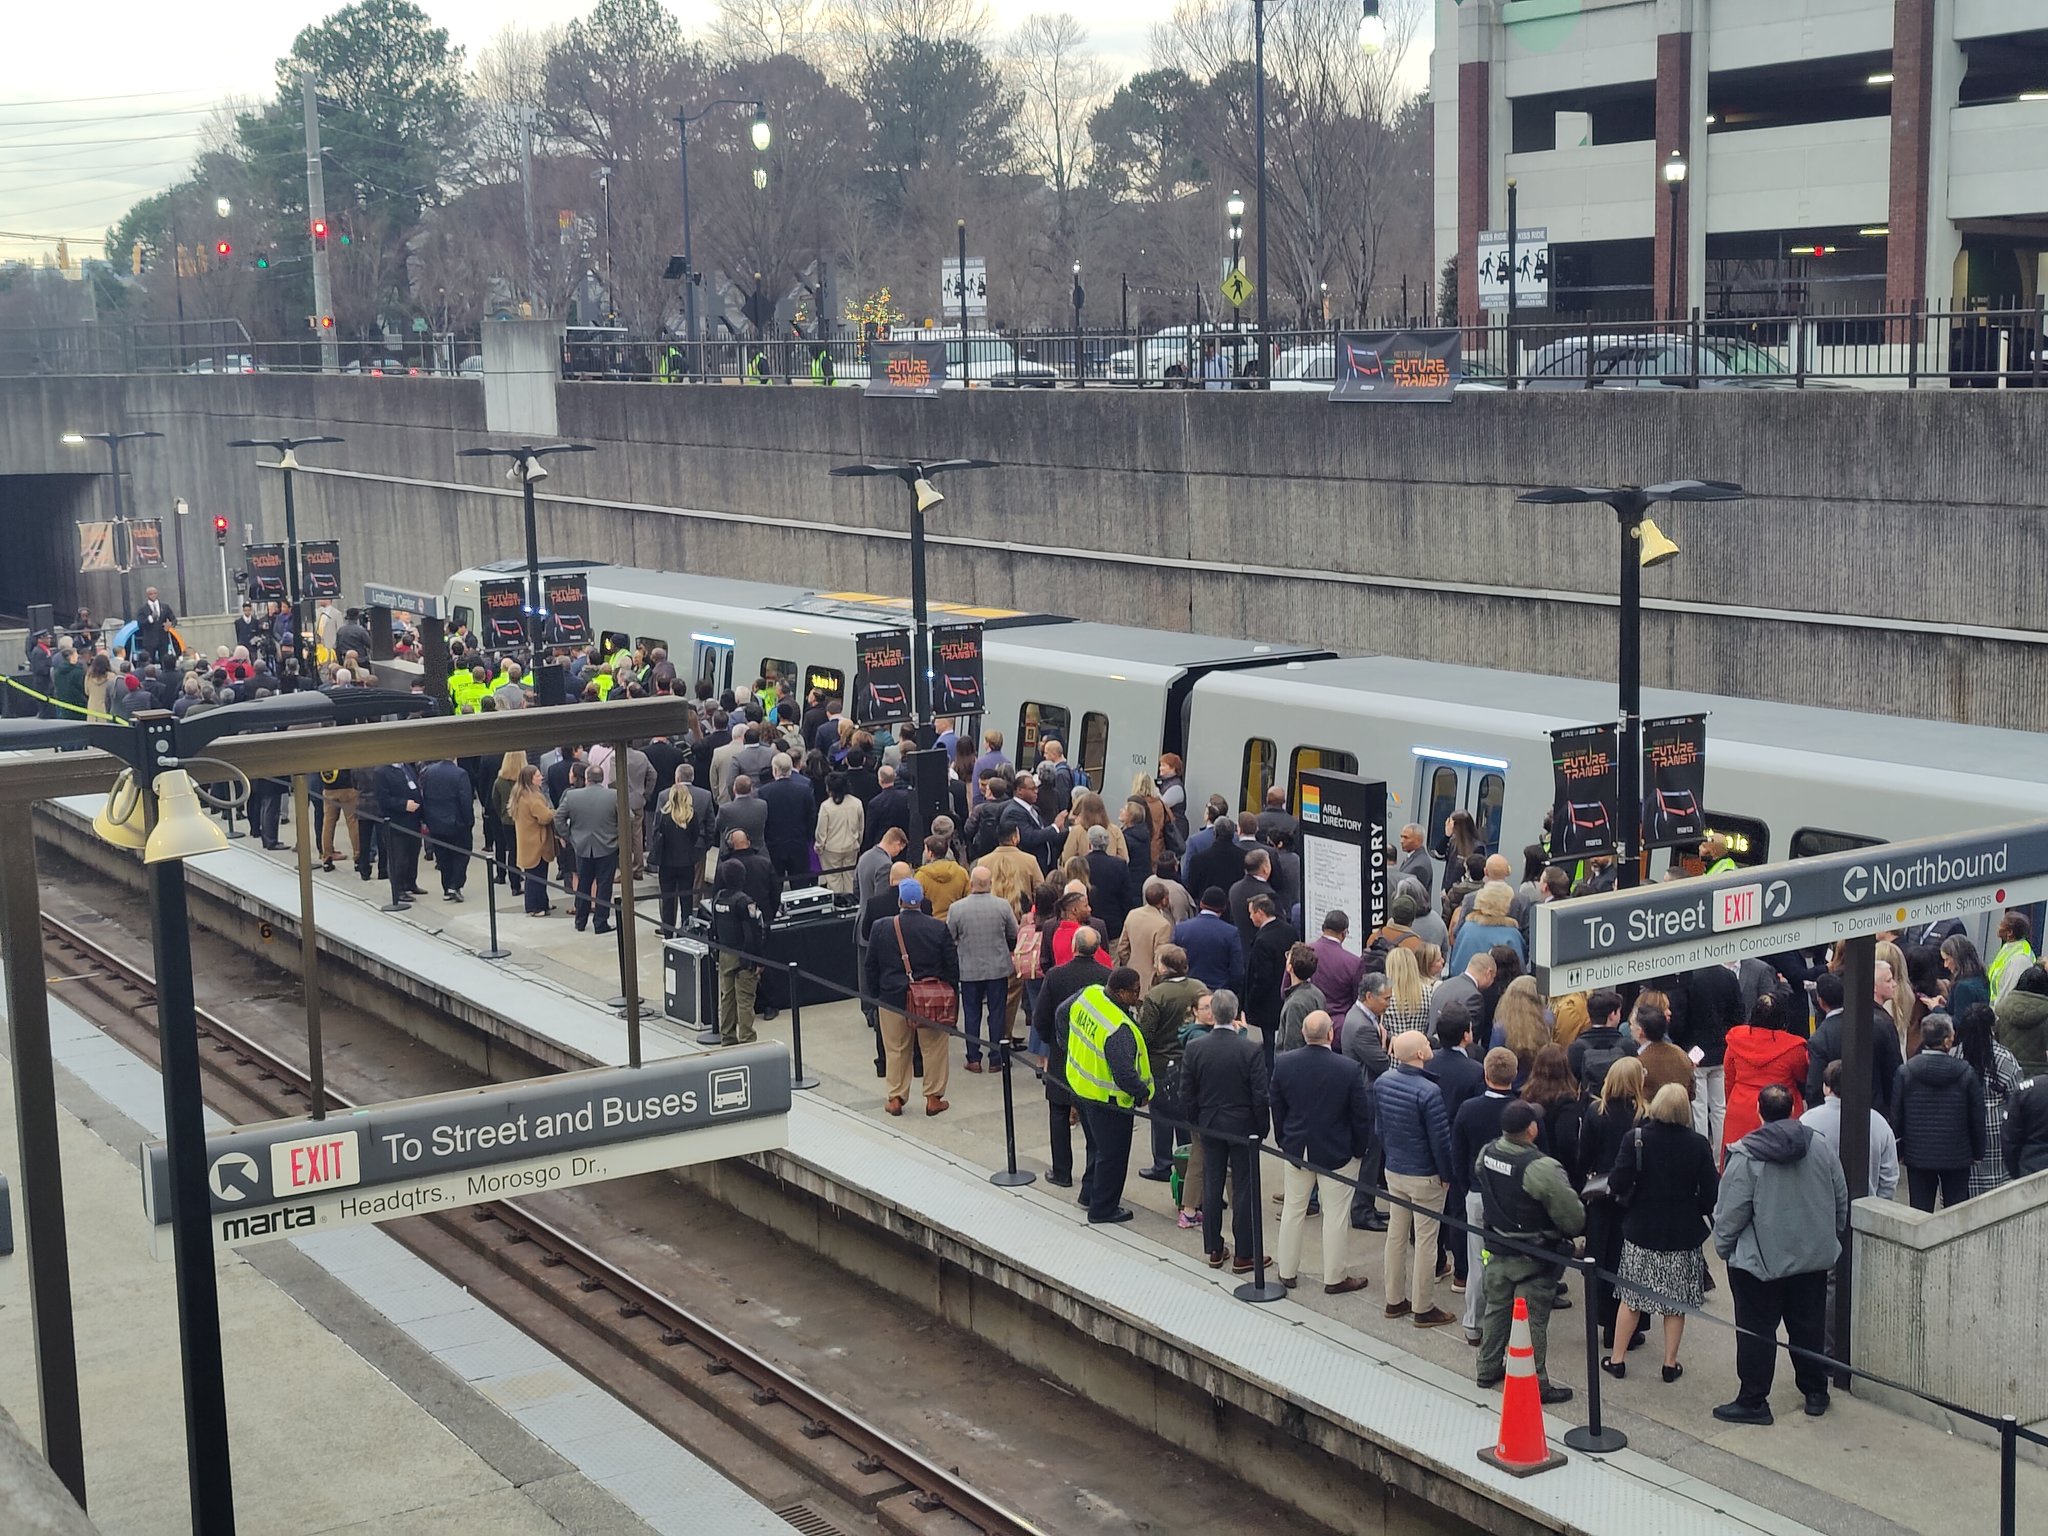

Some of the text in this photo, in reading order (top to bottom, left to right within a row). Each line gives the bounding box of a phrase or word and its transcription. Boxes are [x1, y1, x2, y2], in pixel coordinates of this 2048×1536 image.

[1493, 232, 1507, 241] RIDE
[1517, 230, 1545, 240] KISS RIDE
[888, 360, 928, 373] FUTURE
[1394, 359, 1445, 373] FUTURE
[888, 374, 931, 387] TRANSIT
[1394, 373, 1450, 387] TRANSIT
[398, 595, 415, 610] Center
[941, 642, 976, 652] FUTURE
[865, 649, 903, 660] FUTURE
[941, 649, 978, 660] TRANSIT
[865, 656, 904, 668] TRANSIT
[1652, 742, 1694, 756] FUTURE
[1132, 754, 1146, 765] 1004
[1563, 752, 1607, 769] FUTURE
[1652, 752, 1697, 767] TRANSIT
[1564, 763, 1610, 779] TRANSIT
[1322, 803, 1343, 816] AREA
[1322, 815, 1363, 832] DIRECTORY
[1677, 826, 1693, 834] marta
[1585, 839, 1602, 847] marta
[1873, 843, 2008, 895] Northbound
[1725, 891, 1754, 925] EXIT
[1832, 893, 1992, 934] To Doraville or North Springs
[1584, 899, 1706, 950] To Street
[1586, 931, 1801, 982] Public Restroom at North Concourse
[382, 1089, 698, 1164] To Street and Buses
[290, 1141, 344, 1187] EXIT
[340, 1156, 607, 1219] Headqtrs., Morosgo Dr.,
[223, 1205, 316, 1241] marta
